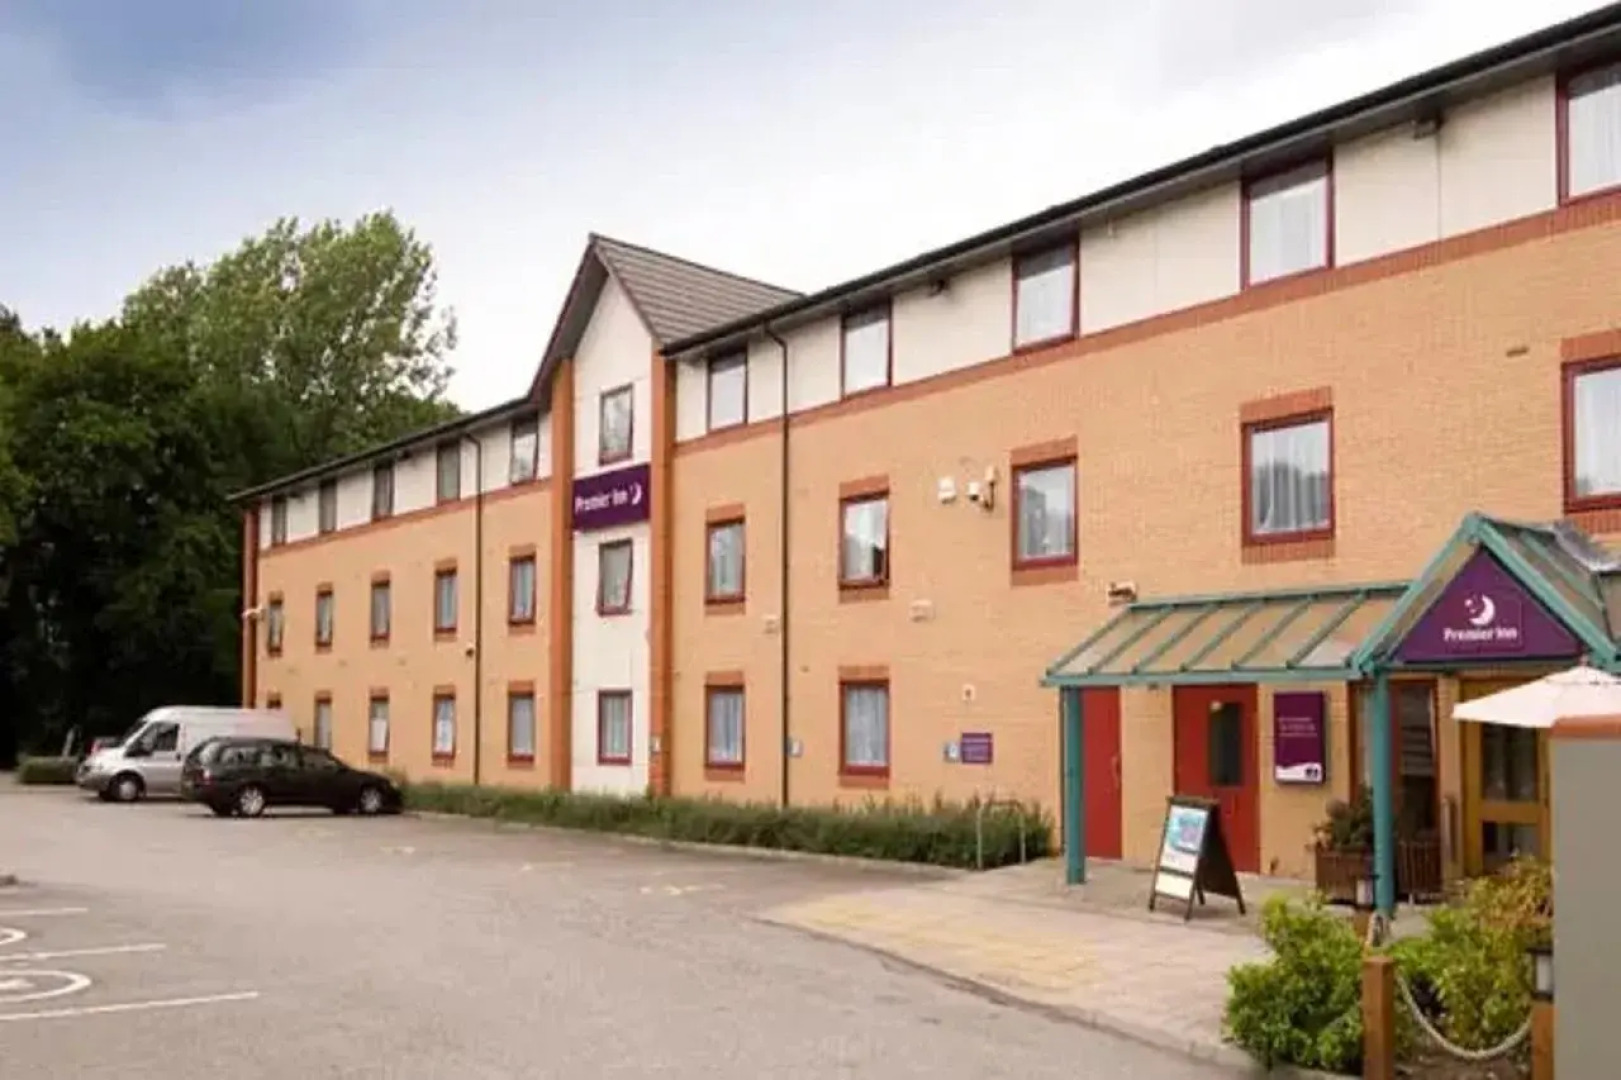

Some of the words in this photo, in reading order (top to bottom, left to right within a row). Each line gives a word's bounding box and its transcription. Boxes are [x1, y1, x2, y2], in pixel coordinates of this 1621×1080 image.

[575, 494, 609, 514] Premier
[612, 488, 628, 506] Inn
[1443, 628, 1494, 641] Premier
[1495, 627, 1518, 640] Inn
